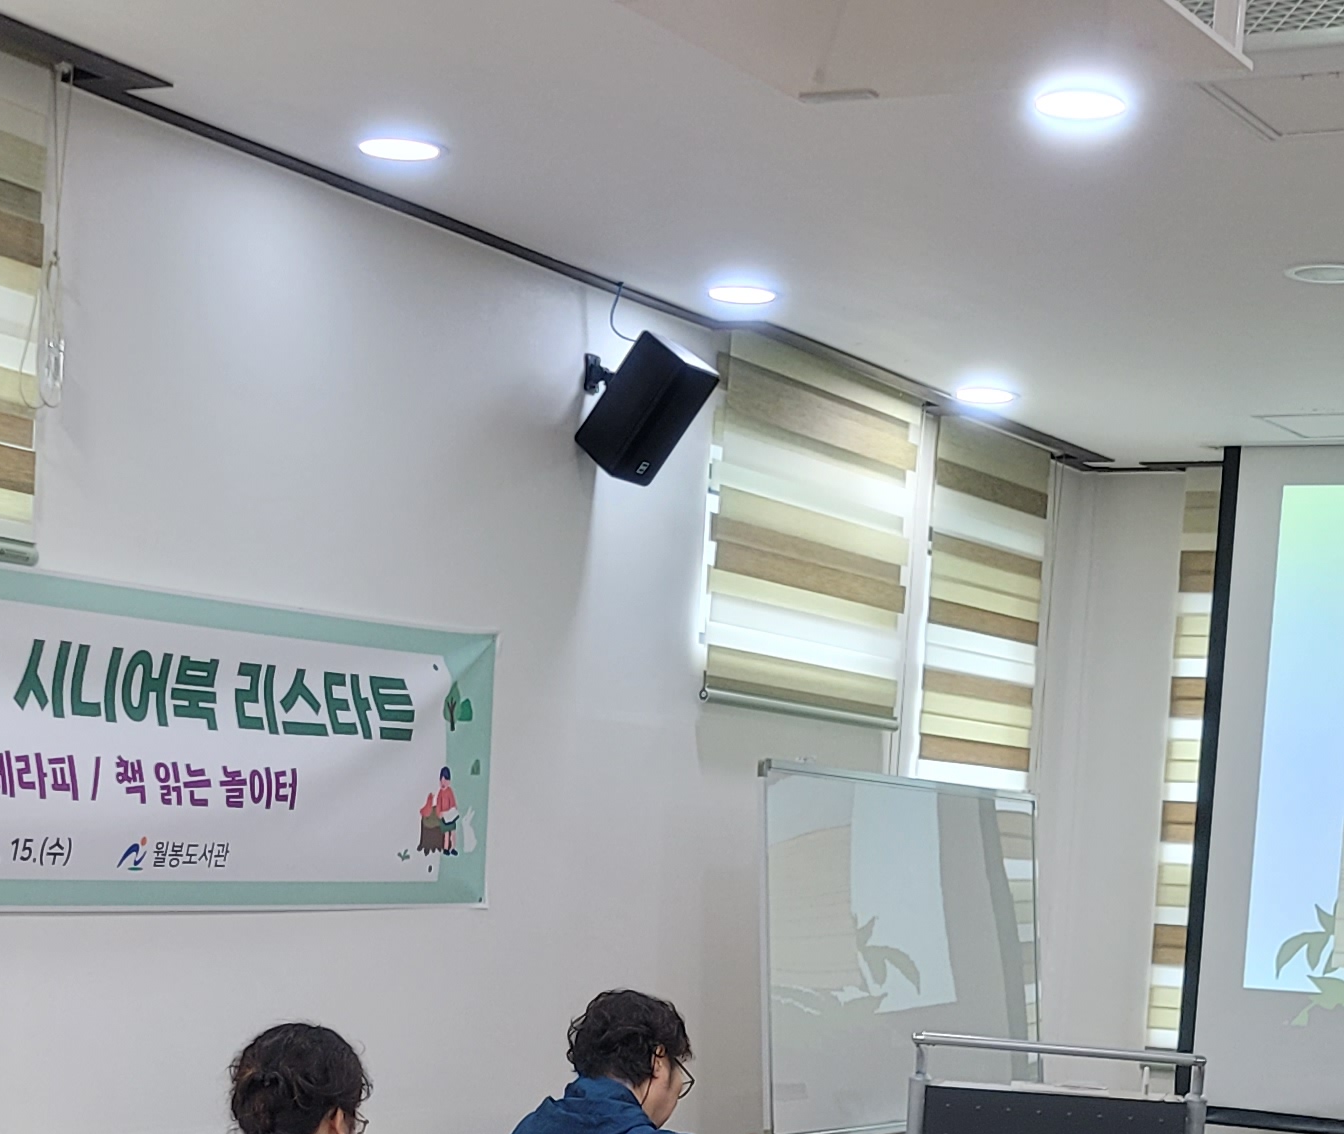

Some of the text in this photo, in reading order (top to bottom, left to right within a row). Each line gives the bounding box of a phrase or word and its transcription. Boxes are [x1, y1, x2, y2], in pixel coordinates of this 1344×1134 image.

[13, 638, 220, 731] 시니어북
[234, 661, 416, 741] 리스타트
[90, 756, 101, 801] /
[115, 755, 147, 805] 책
[154, 760, 212, 807] 읽는
[218, 765, 298, 810] 놀이터
[152, 839, 230, 869] 월봉도서관
